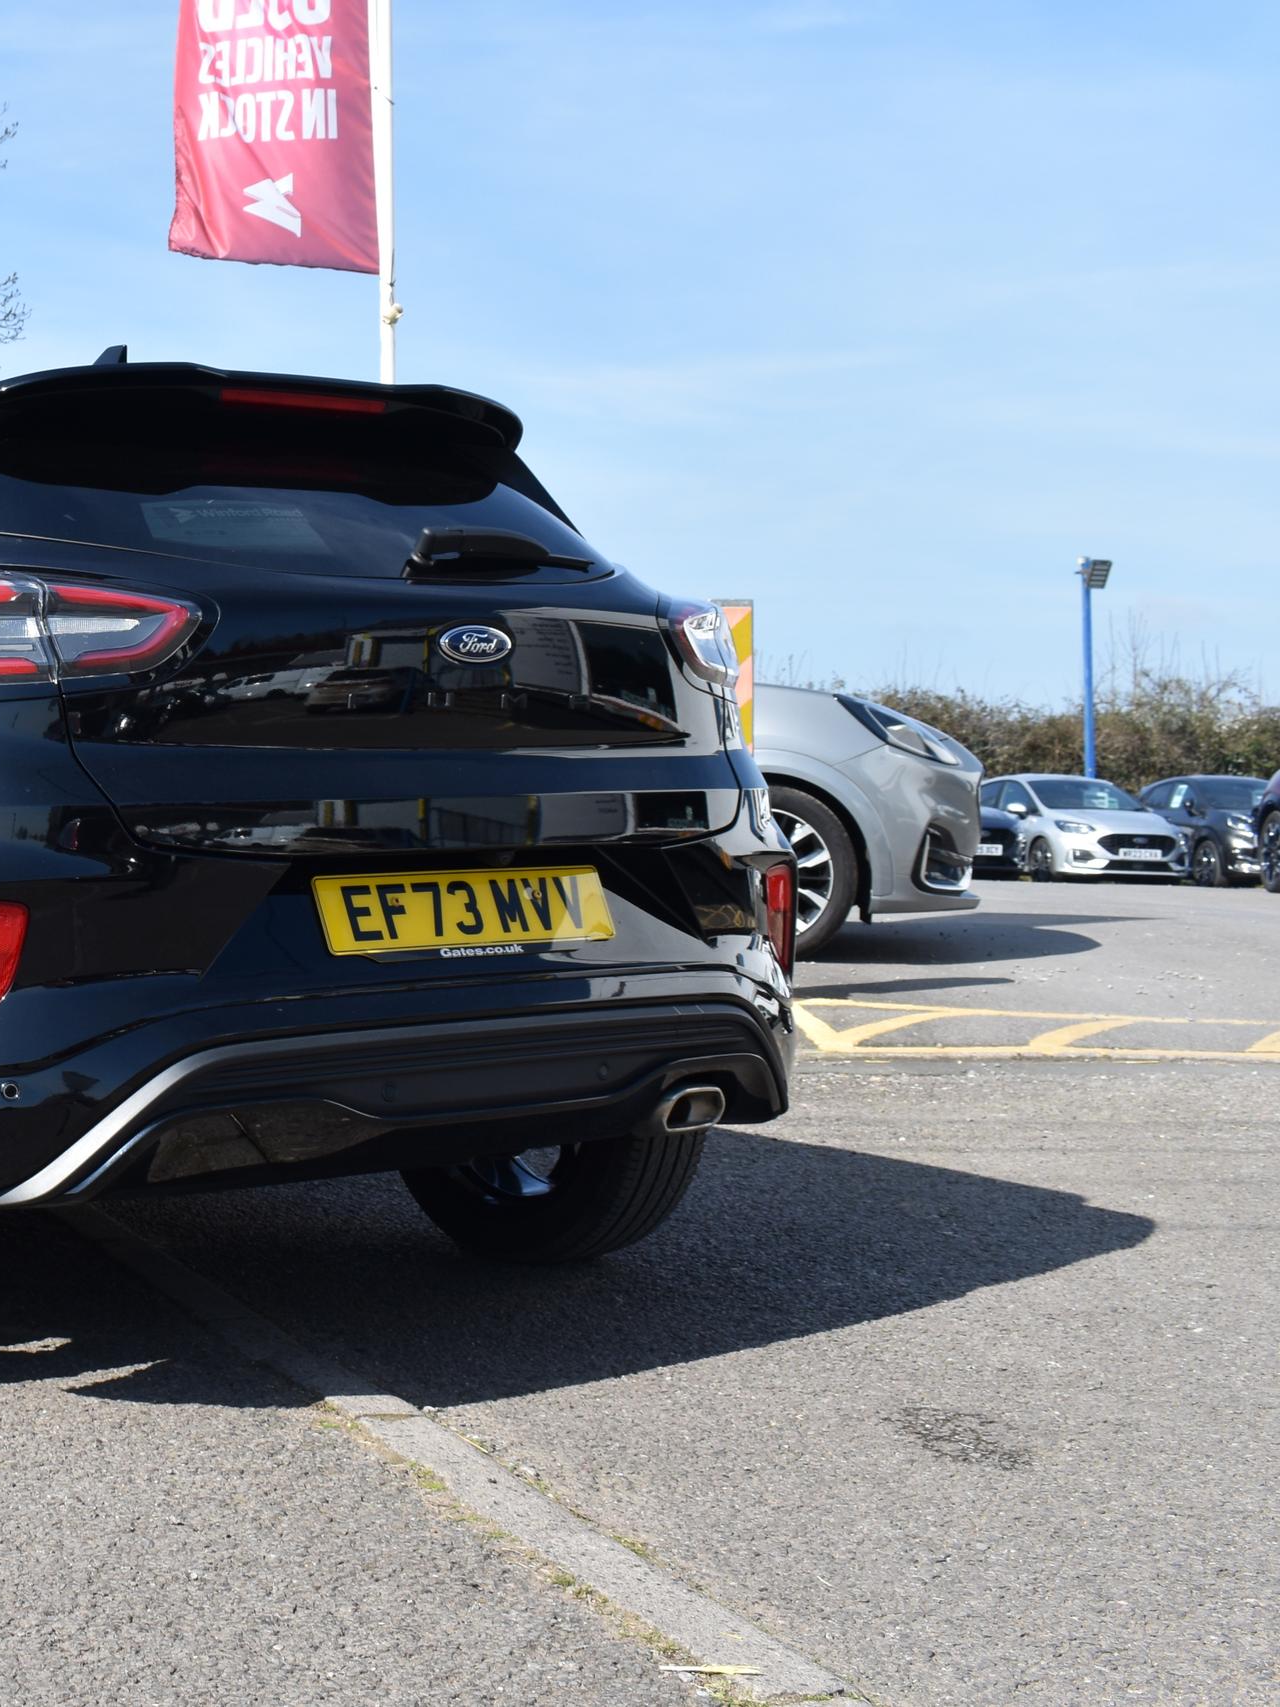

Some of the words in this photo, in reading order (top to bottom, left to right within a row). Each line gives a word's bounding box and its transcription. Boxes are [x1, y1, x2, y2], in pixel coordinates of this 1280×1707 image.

[460, 632, 497, 653] Ford
[340, 880, 484, 942] EF73
[488, 876, 584, 934] MVV
[440, 944, 524, 958] Gates.co.uk
